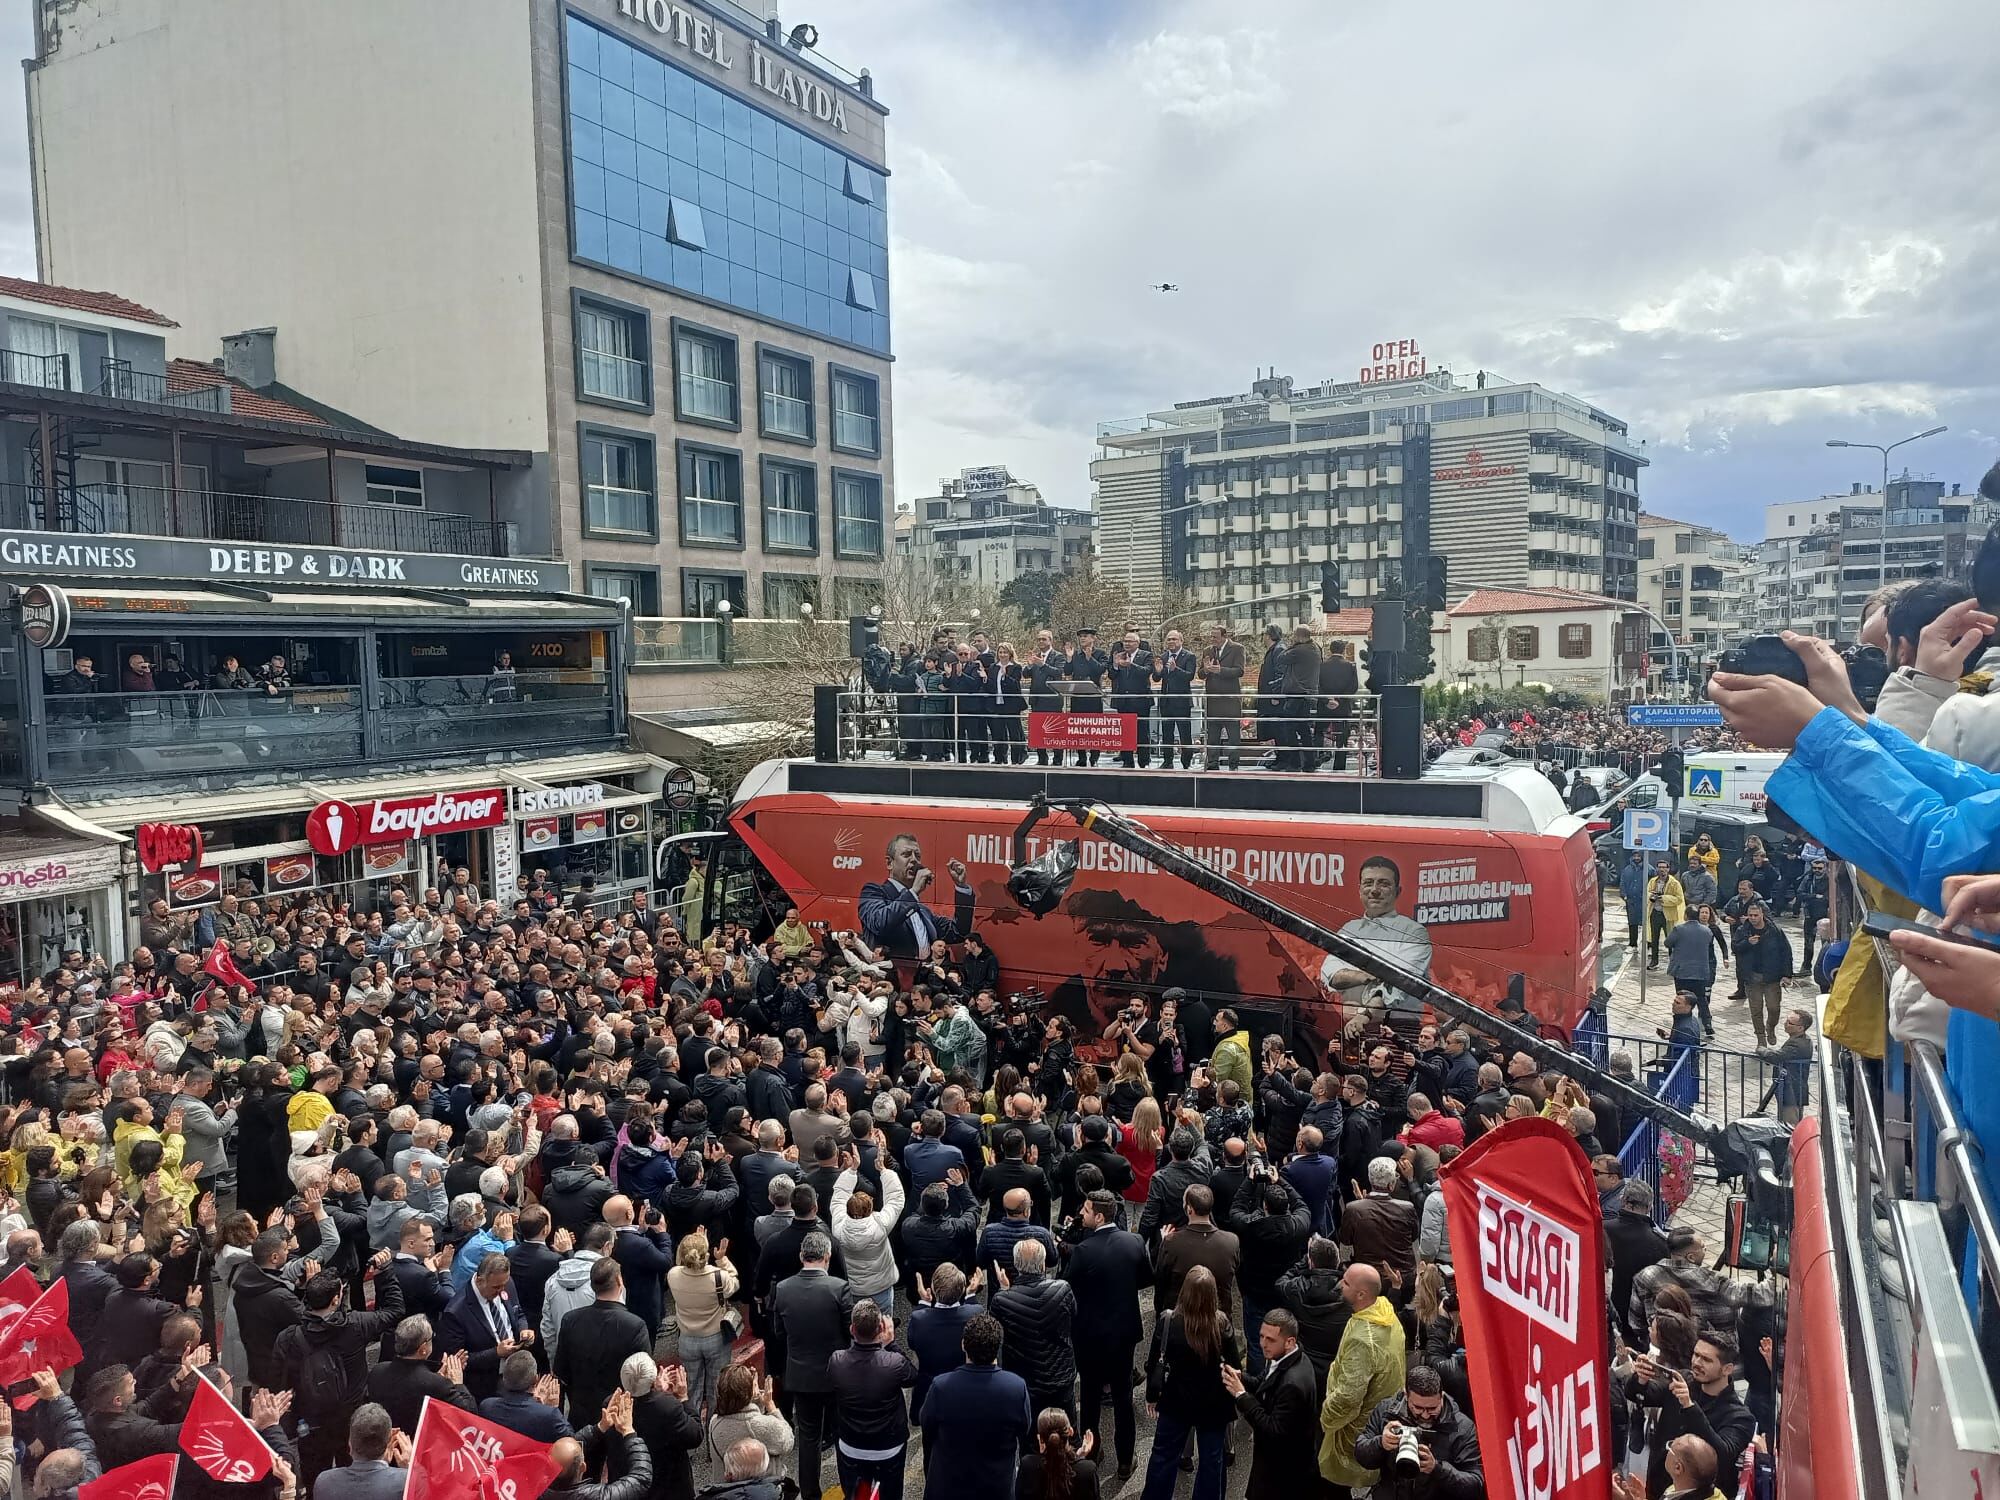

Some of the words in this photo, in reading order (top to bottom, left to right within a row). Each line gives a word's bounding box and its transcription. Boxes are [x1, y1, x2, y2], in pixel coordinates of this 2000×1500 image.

[751, 40, 849, 134] İLAYDA
[1373, 339, 1420, 361] OTEL
[1, 538, 137, 569] GREATNESS
[209, 547, 293, 575] DEEP
[300, 554, 319, 575] &
[328, 554, 407, 580] DARK
[461, 563, 539, 585] GREATNESS
[1067, 715, 1122, 726] CUMHURİYET
[1645, 708, 1677, 716] KAPALI
[1067, 727, 1089, 735] HALK
[1090, 726, 1122, 736] PARTİSİ
[1101, 738, 1122, 747] Partisi
[370, 792, 498, 840] baydöner
[832, 855, 863, 870] CHP
[1244, 849, 1345, 886] ÇIKIYOR
[1418, 865, 1477, 885] EKREM
[1417, 901, 1505, 924] ÖZGÜRLÜK
